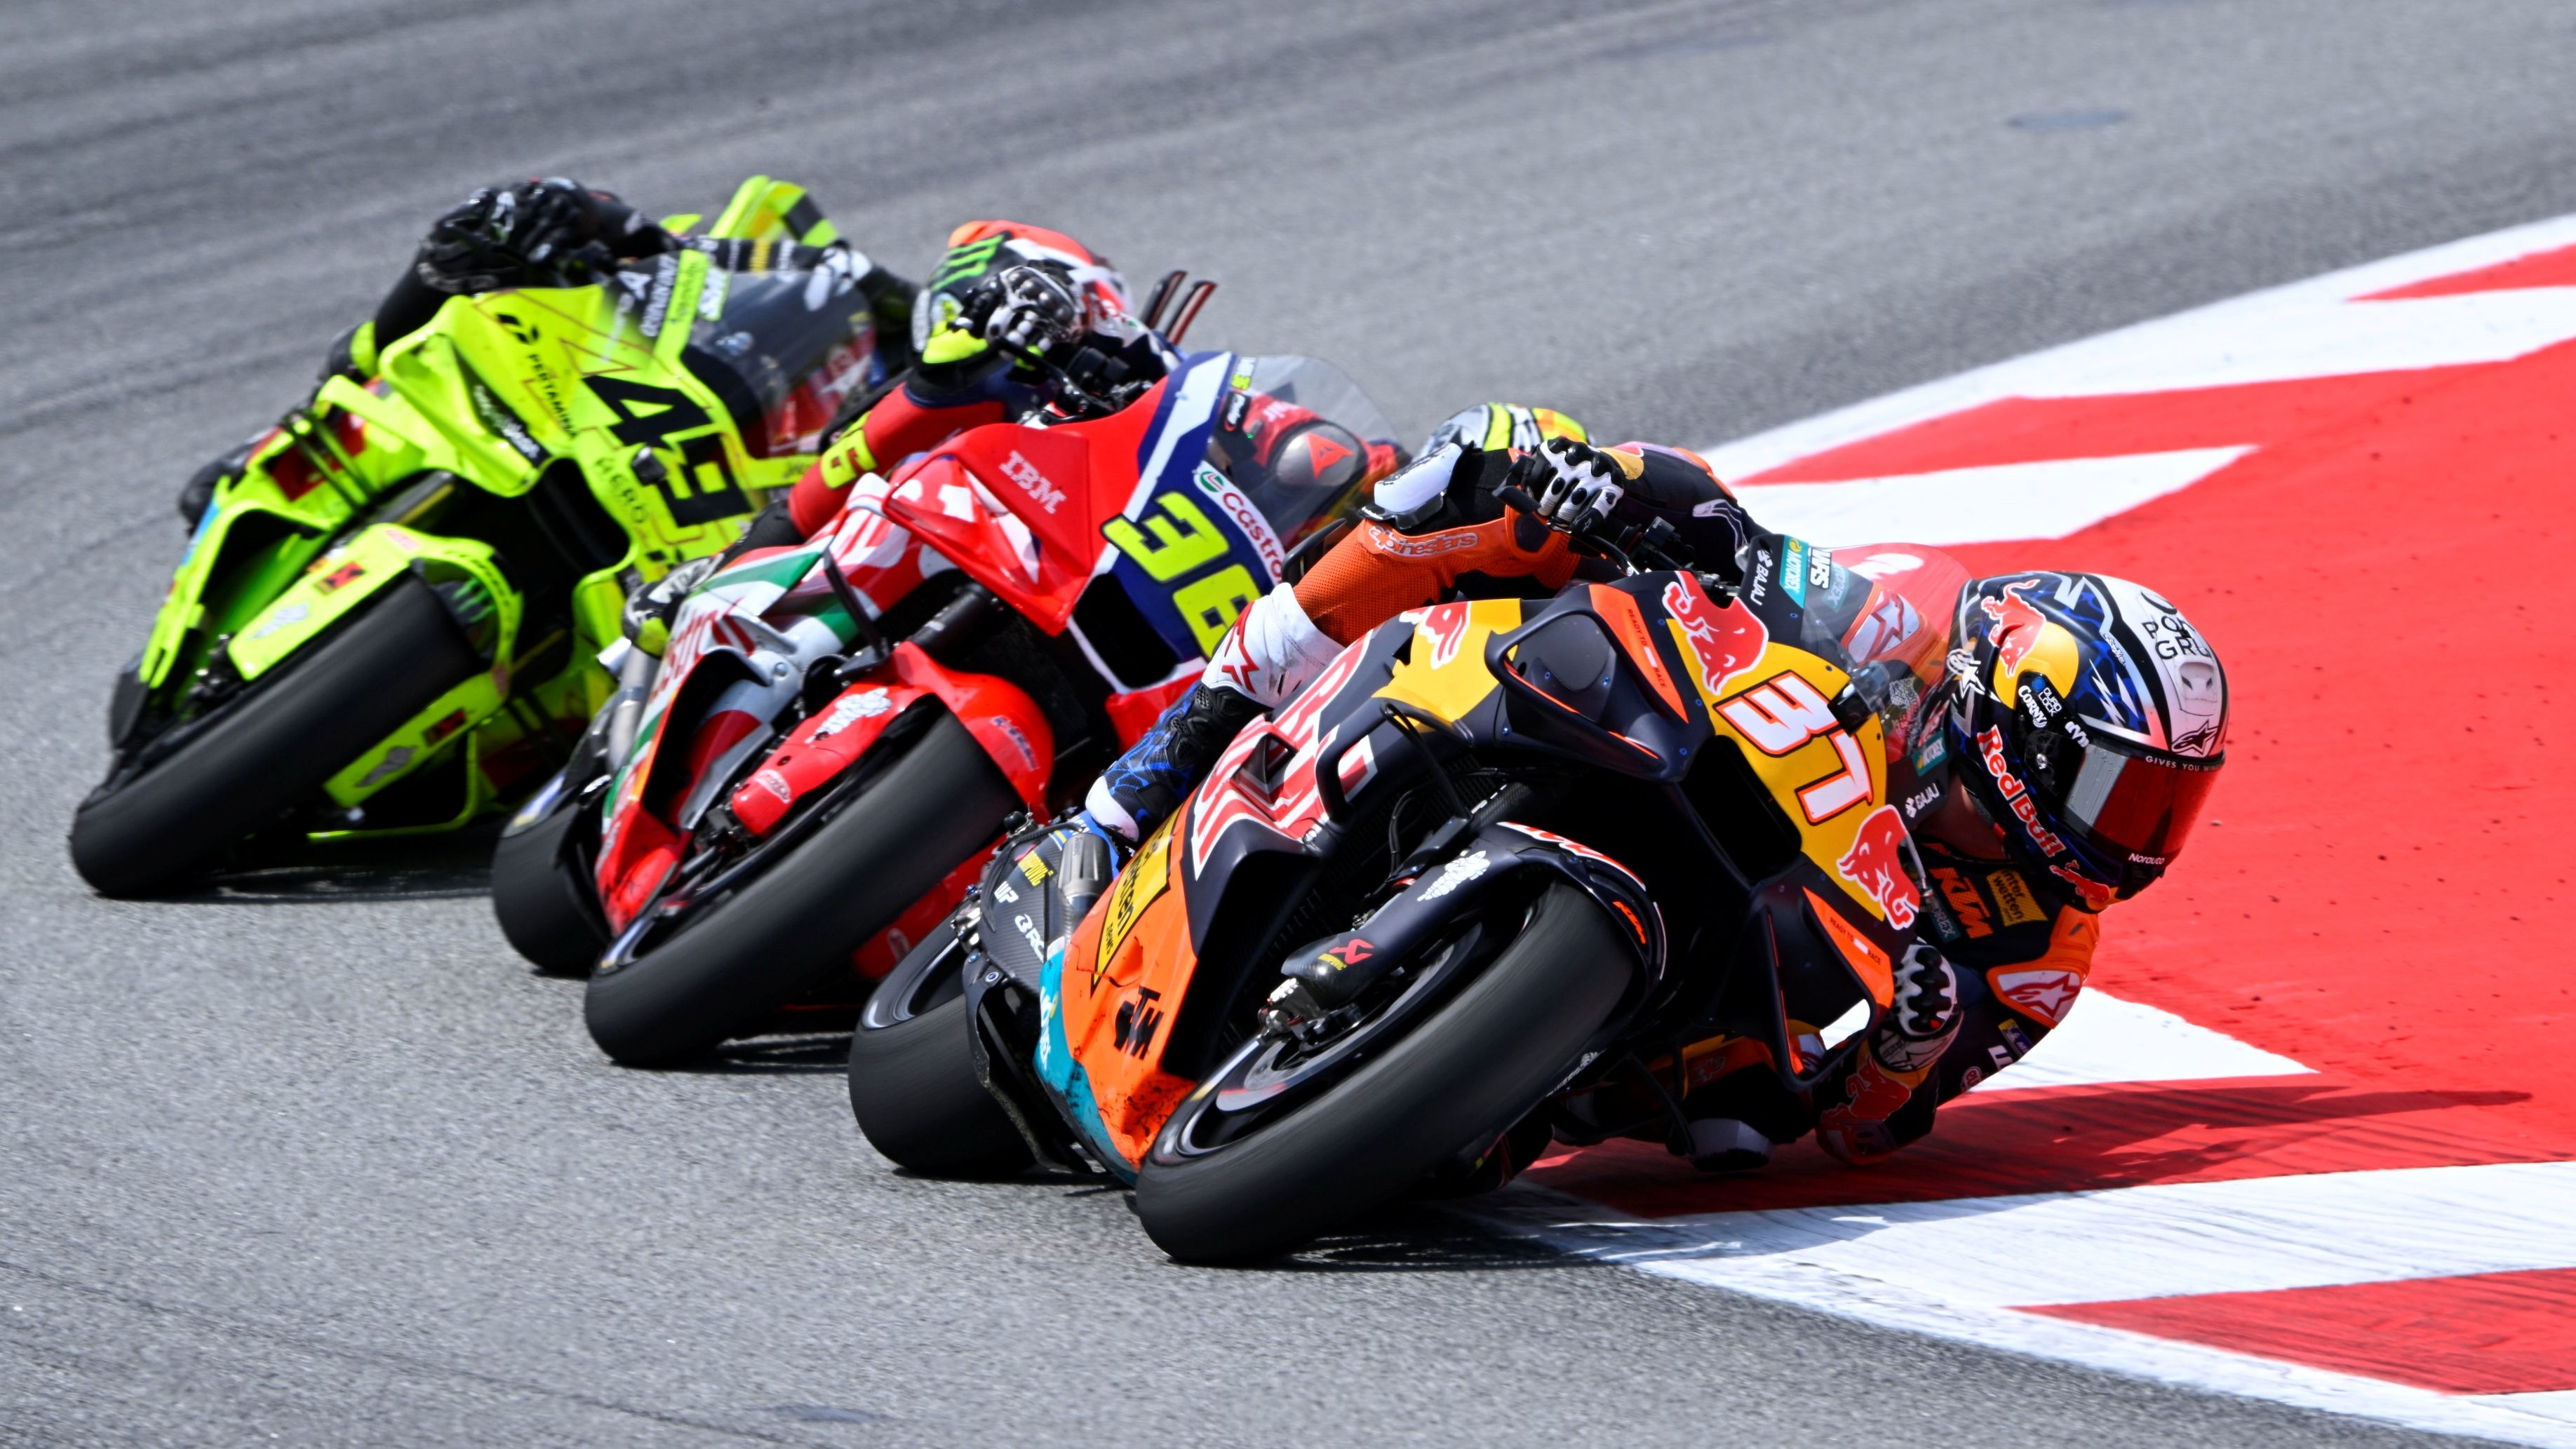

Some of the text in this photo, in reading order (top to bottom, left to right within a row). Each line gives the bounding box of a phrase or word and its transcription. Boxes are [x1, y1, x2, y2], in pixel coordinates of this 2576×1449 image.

[582, 374, 753, 528] 49
[999, 450, 1067, 514] IBM
[1222, 492, 1283, 584] Castro
[1100, 490, 1264, 663] 36
[1750, 562, 1771, 606] BAJAJ
[1784, 549, 1802, 595] MOTOREX
[1810, 547, 1831, 589] WRS
[1628, 608, 1667, 687] READY TO RACE
[2018, 685, 2048, 727] CORNY
[2037, 692, 2058, 717] LOCK
[2043, 687, 2063, 712] QUAD
[1713, 669, 1874, 825] 37
[2145, 755, 2222, 772] GIVES YOU WIN
[1977, 724, 2067, 858] Red Bull
[2128, 853, 2166, 865] Norauto
[994, 881, 1019, 903] WP
[1929, 868, 1994, 938] KTM
[1993, 876, 2025, 919] wetten
[1830, 917, 1882, 966] READY TO RACE
